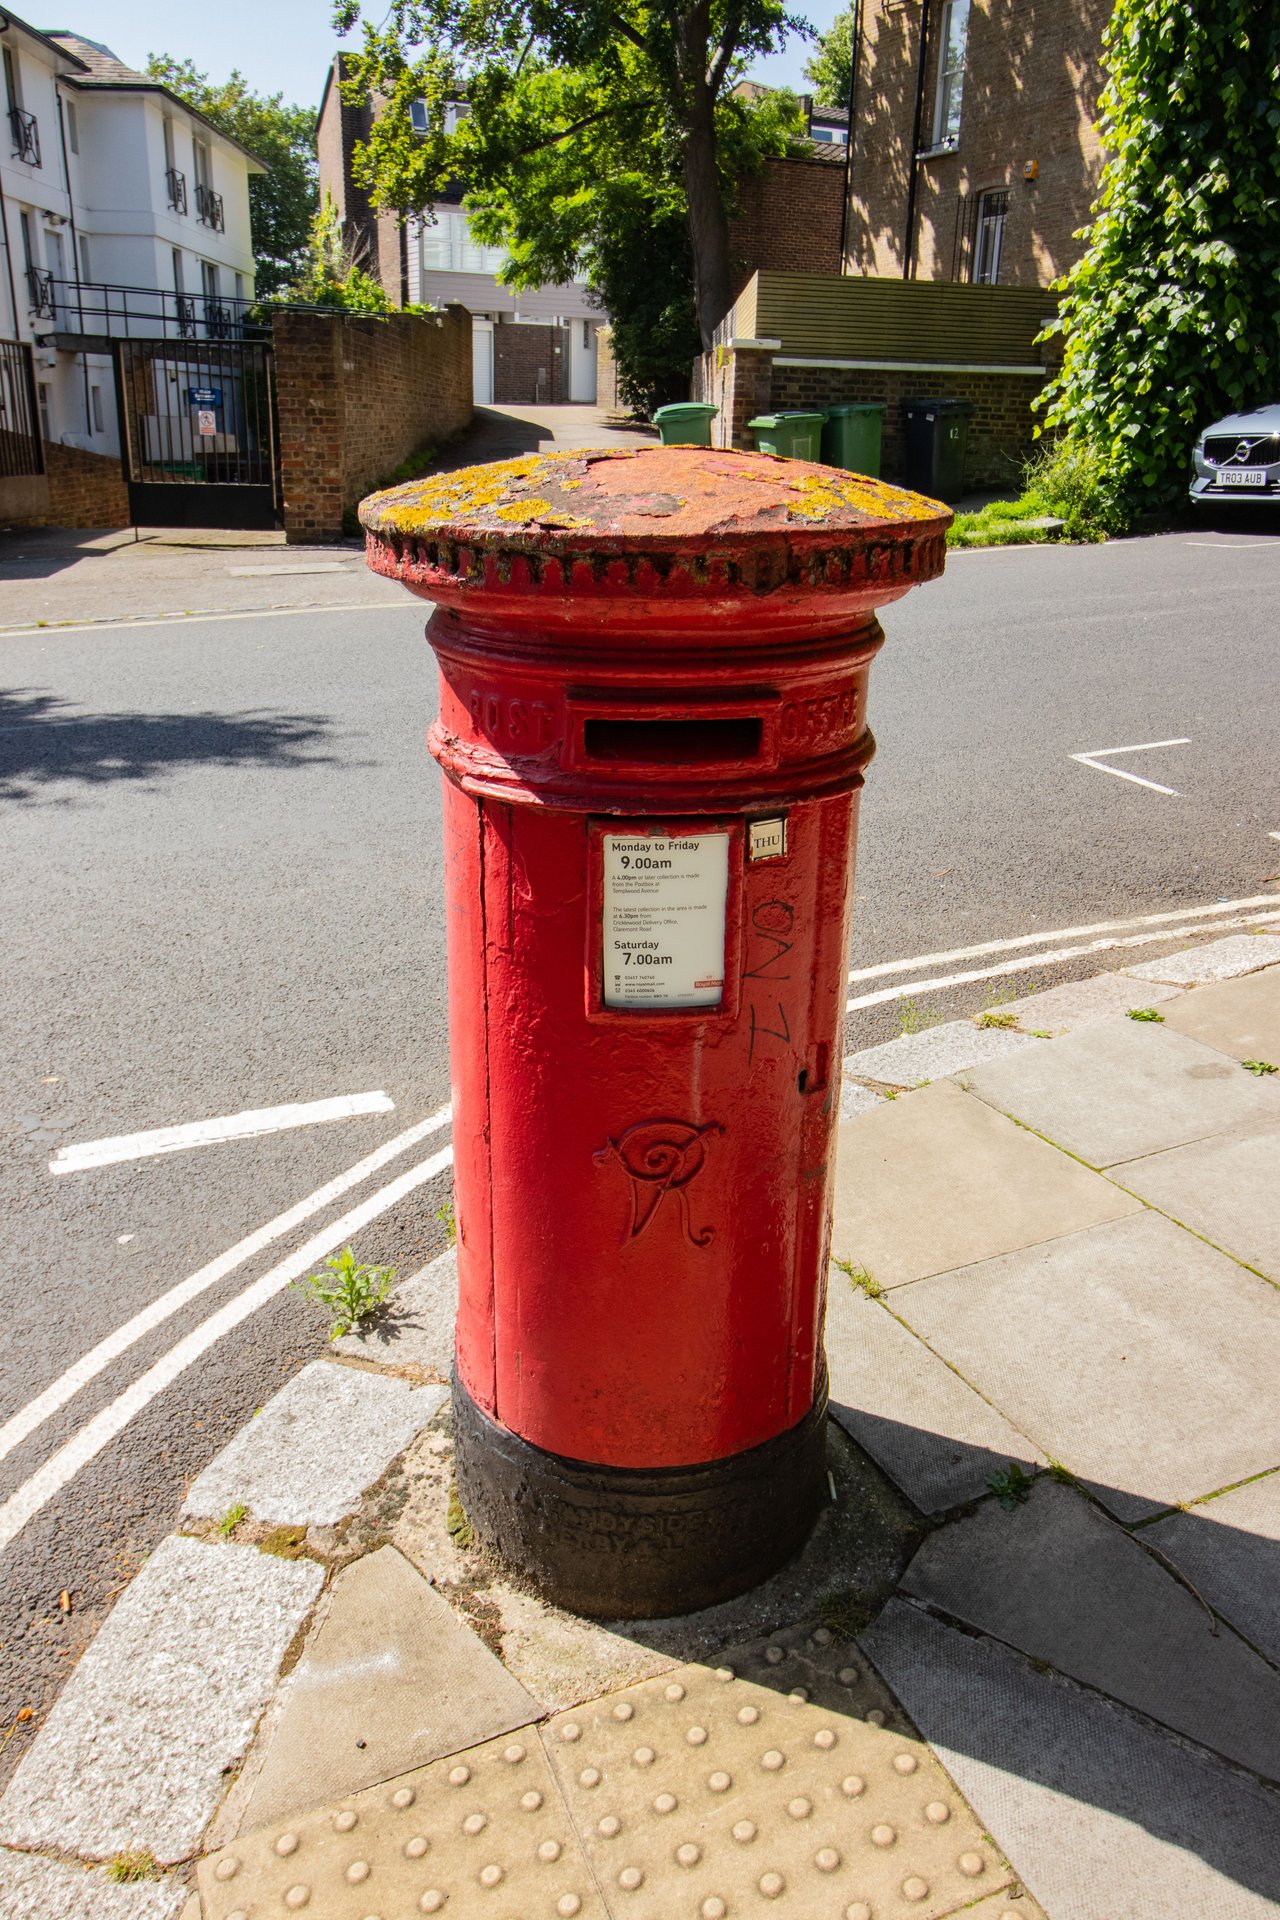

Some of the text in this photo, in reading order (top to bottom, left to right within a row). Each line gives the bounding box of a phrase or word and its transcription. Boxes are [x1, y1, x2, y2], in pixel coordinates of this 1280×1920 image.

[949, 428, 960, 439] 12
[1221, 473, 1262, 484] TR03 AUB
[612, 841, 700, 853] Monday to Friday
[754, 835, 780, 848] THU
[620, 855, 672, 869] 9.00am
[614, 940, 659, 950] Saturday
[622, 953, 673, 965] 7.00am
